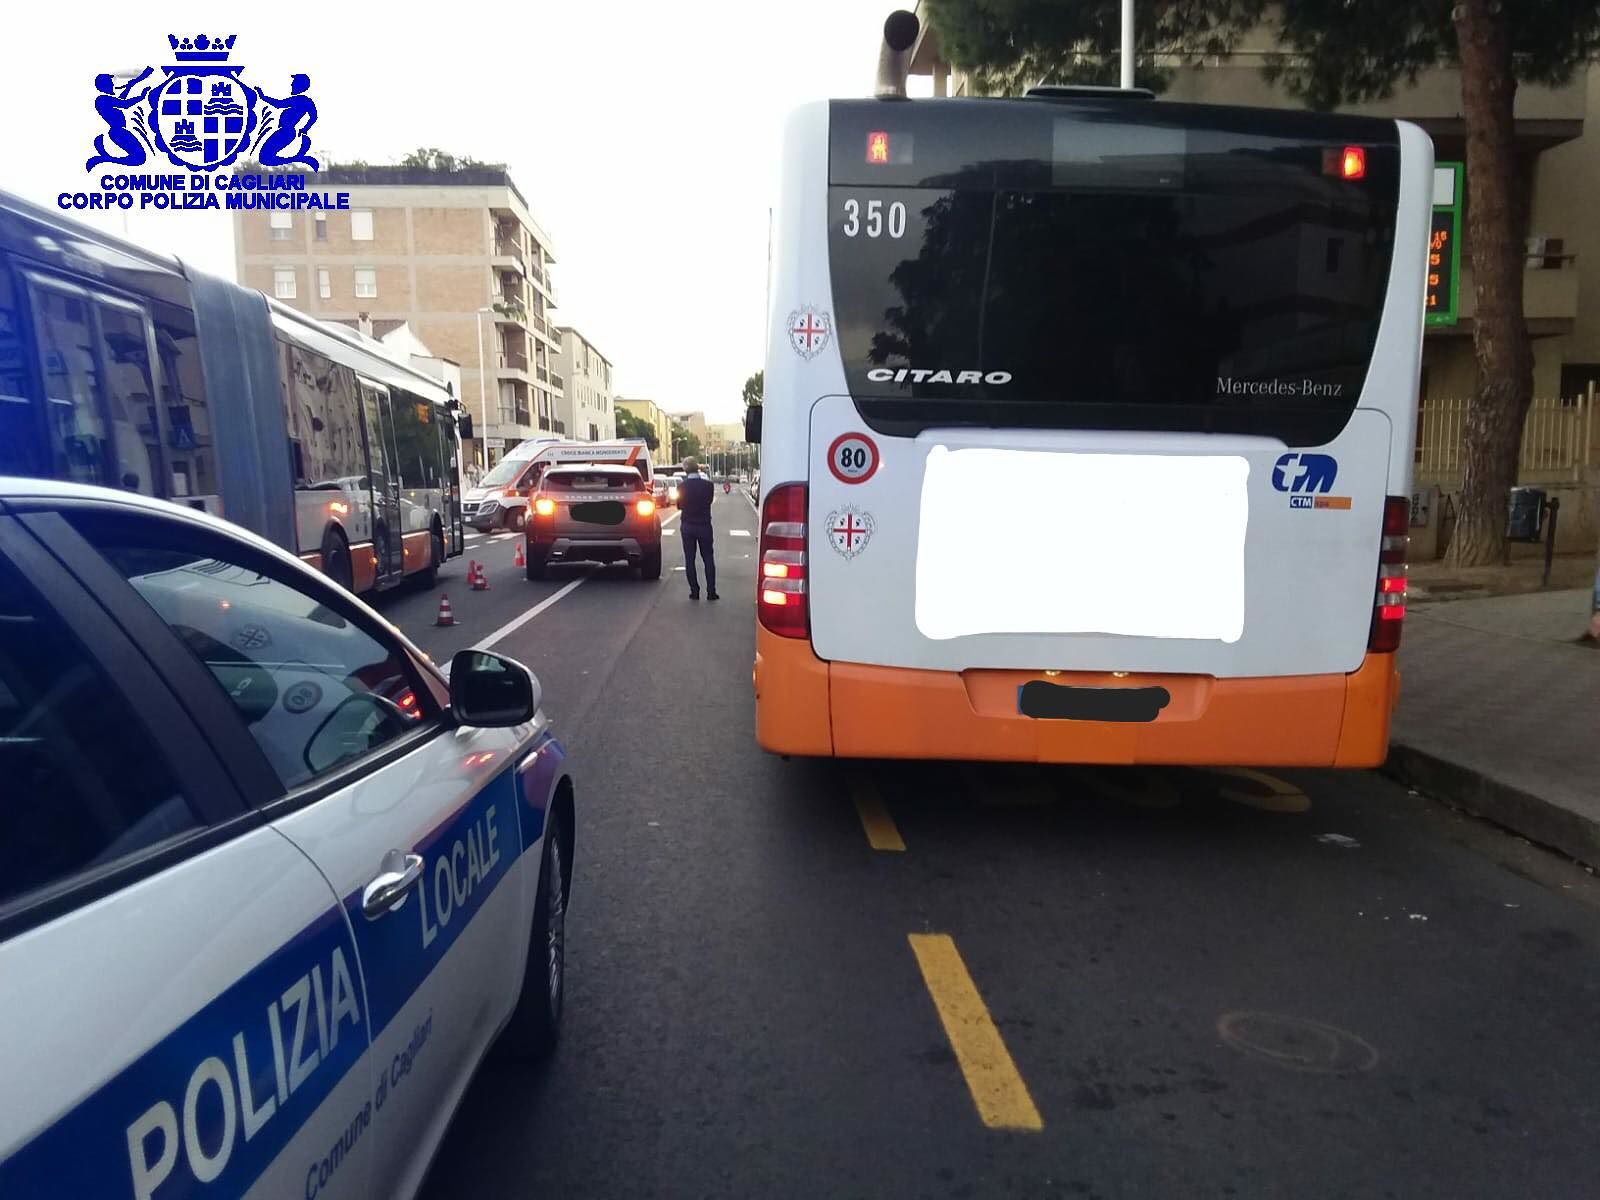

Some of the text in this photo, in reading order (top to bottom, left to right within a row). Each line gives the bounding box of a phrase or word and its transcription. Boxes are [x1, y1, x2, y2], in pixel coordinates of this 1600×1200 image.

[843, 198, 906, 239] 350
[866, 368, 1013, 386] CITARO
[1216, 376, 1343, 397] Mercedes-Benz
[841, 447, 866, 469] 80
[1291, 497, 1312, 507] CTM
[126, 804, 500, 1200] POLIZIA LOCALE
[305, 1007, 433, 1200] Comune di Cagliari
